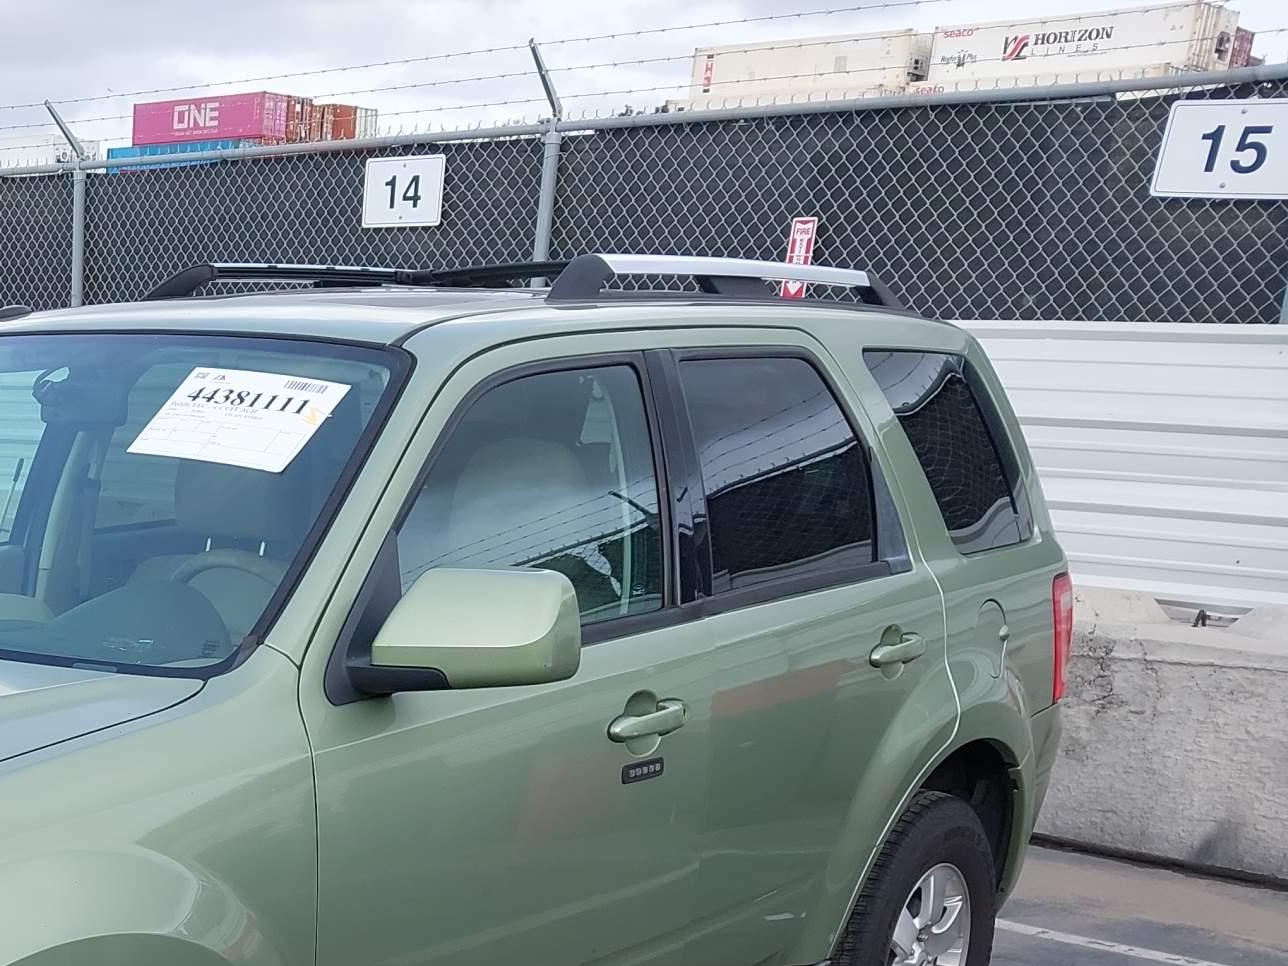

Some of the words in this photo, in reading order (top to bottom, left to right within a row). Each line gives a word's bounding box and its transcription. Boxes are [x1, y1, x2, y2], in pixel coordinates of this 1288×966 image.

[942, 28, 974, 39] seaco
[1032, 26, 1114, 46] HORIZON
[173, 102, 220, 130] ONE
[1201, 125, 1274, 174] 15
[384, 174, 422, 210] 14
[186, 386, 311, 415] 44381111
